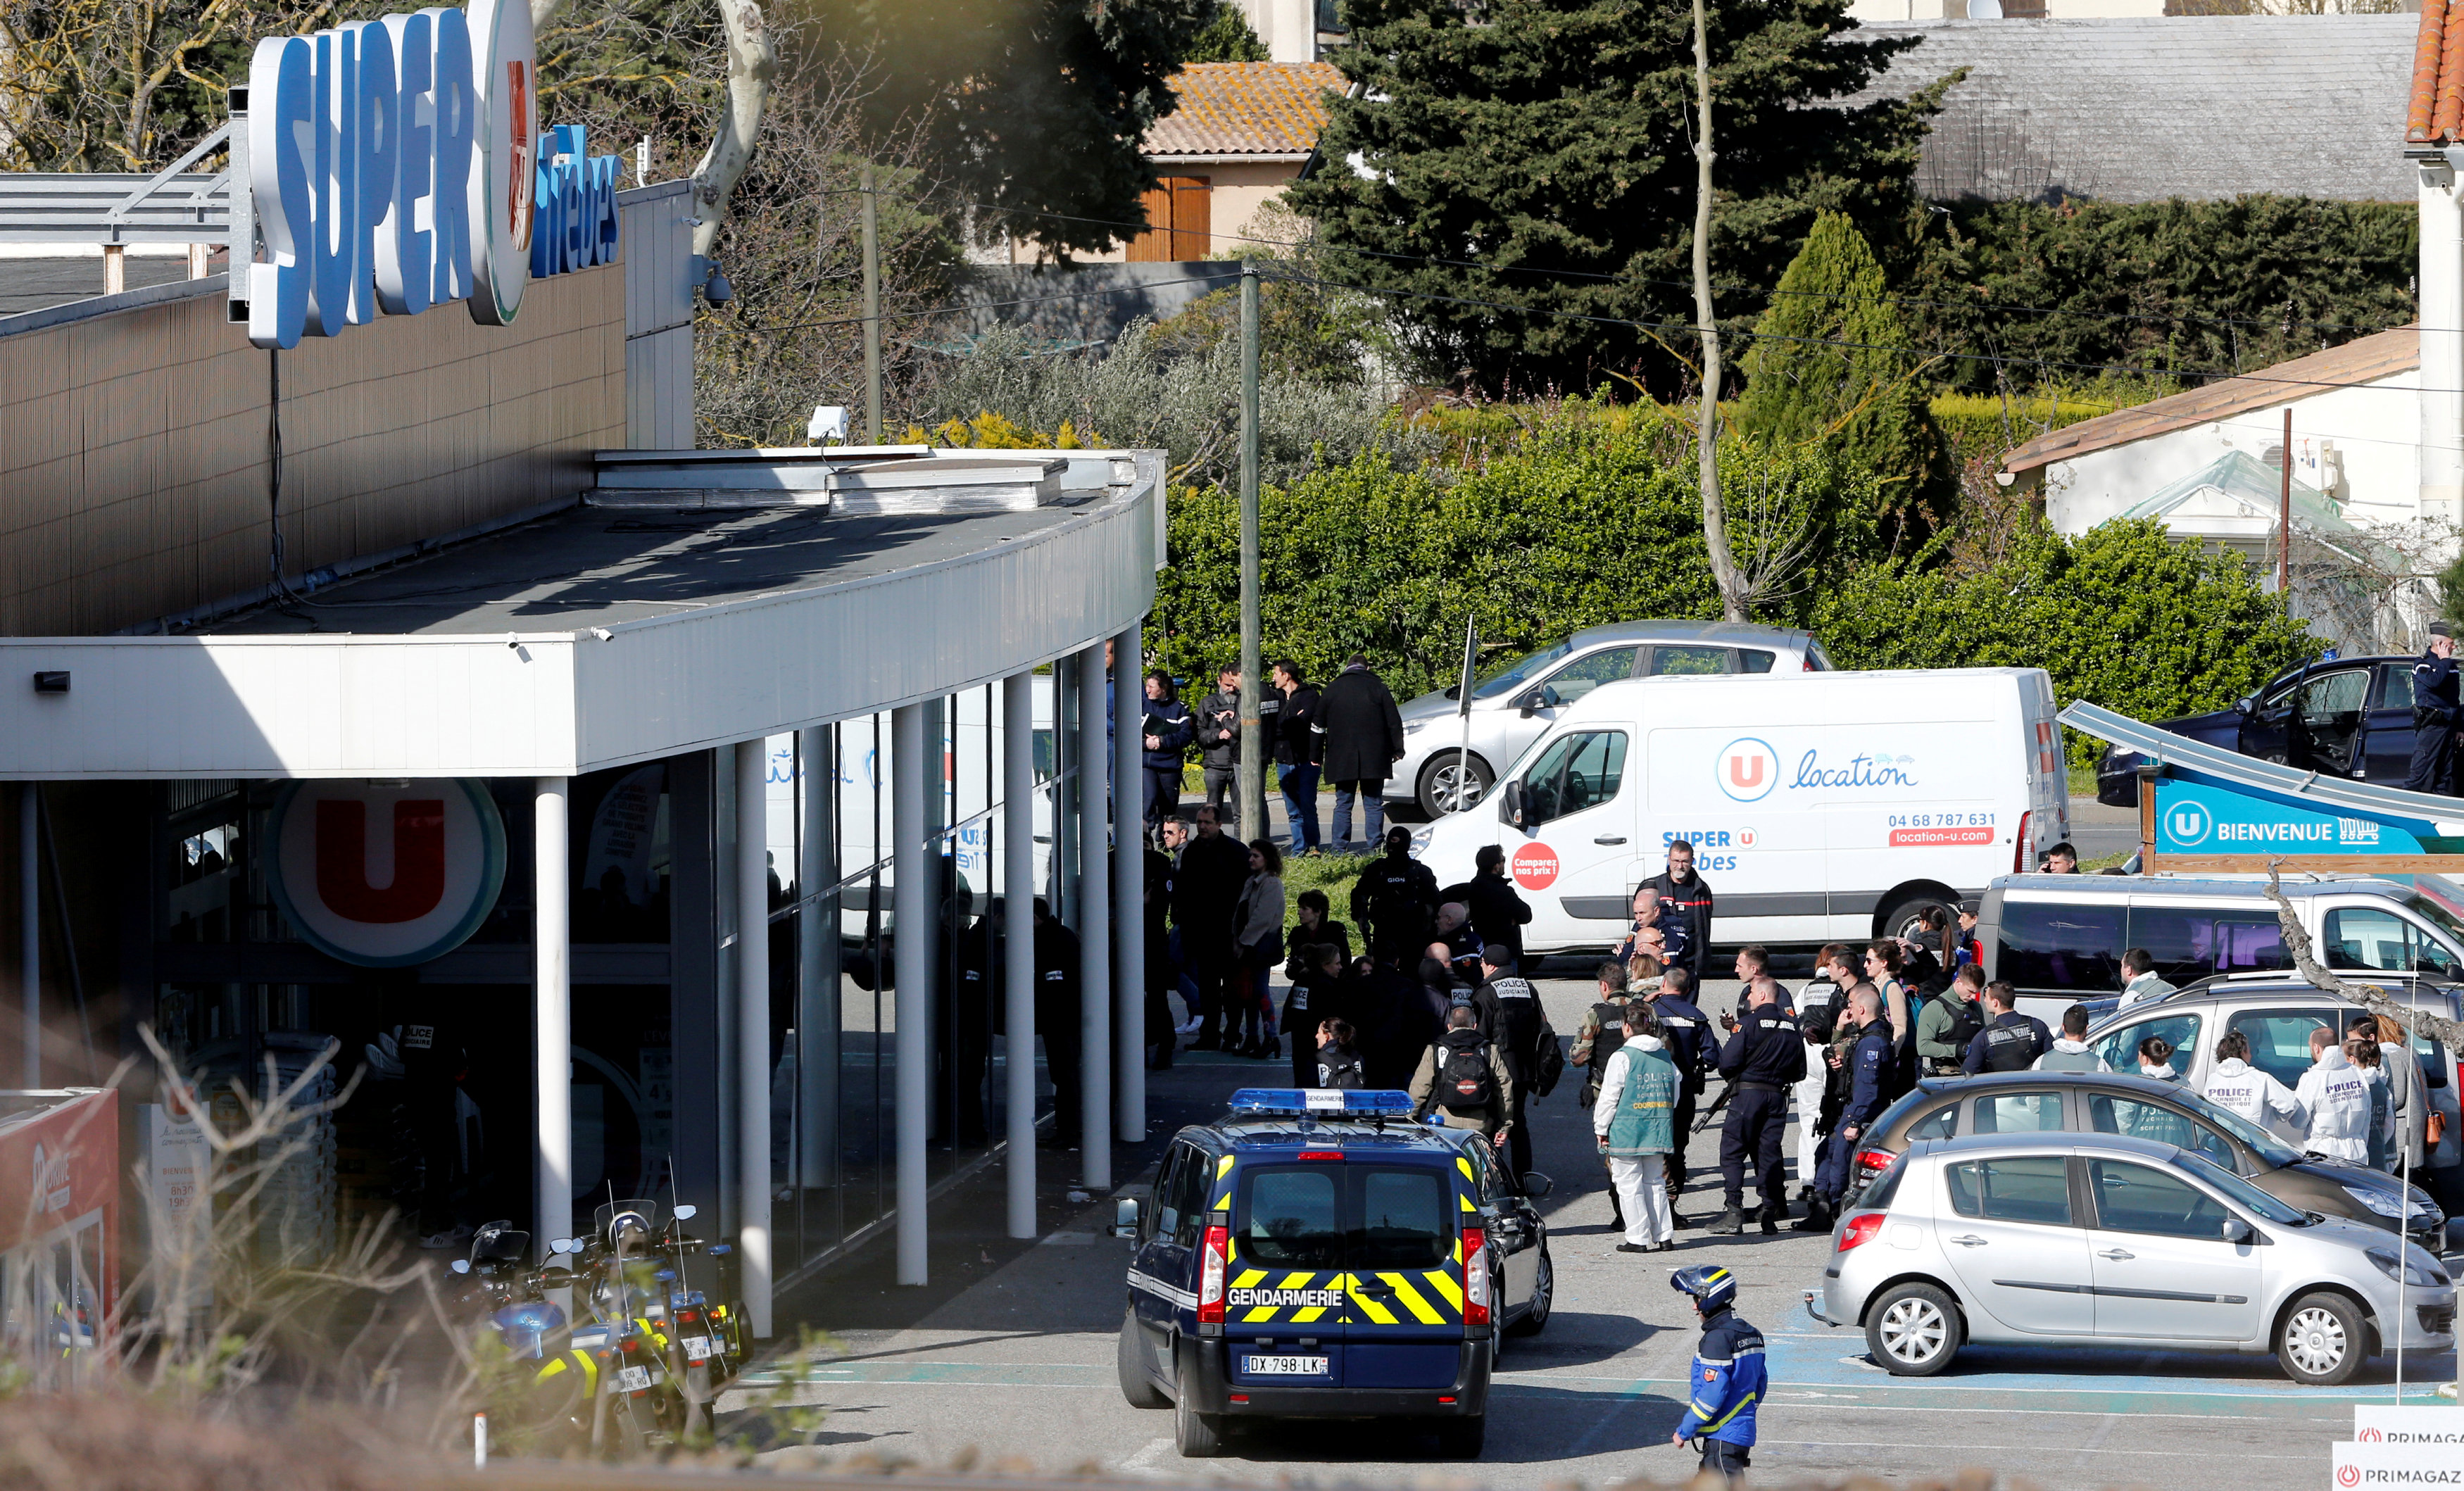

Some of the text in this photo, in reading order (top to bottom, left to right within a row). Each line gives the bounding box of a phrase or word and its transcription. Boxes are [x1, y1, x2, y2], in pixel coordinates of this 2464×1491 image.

[273, 7, 475, 350] SUPER
[1730, 749, 1919, 789] U location
[1889, 813, 1995, 827] 04 68 787 631
[2175, 813, 2332, 841] U BIENVENUE
[1741, 833, 1753, 845] U
[1896, 831, 1987, 843] location-u.com
[316, 800, 445, 924] U
[1514, 858, 1557, 868] Comparez
[1516, 867, 1532, 875] nos
[1533, 866, 1551, 876] prix
[1493, 980, 1527, 989] POLICE
[1637, 1073, 1673, 1083] POLICE
[2208, 1088, 2253, 1097] POLICE
[2327, 1080, 2363, 1094] POLICE
[46, 1152, 70, 1190] DRIVE
[171, 1185, 194, 1196] 8h30
[1228, 1289, 1343, 1306] GENDARMERIE
[2365, 1470, 2462, 1484] PRIMAGAZ
